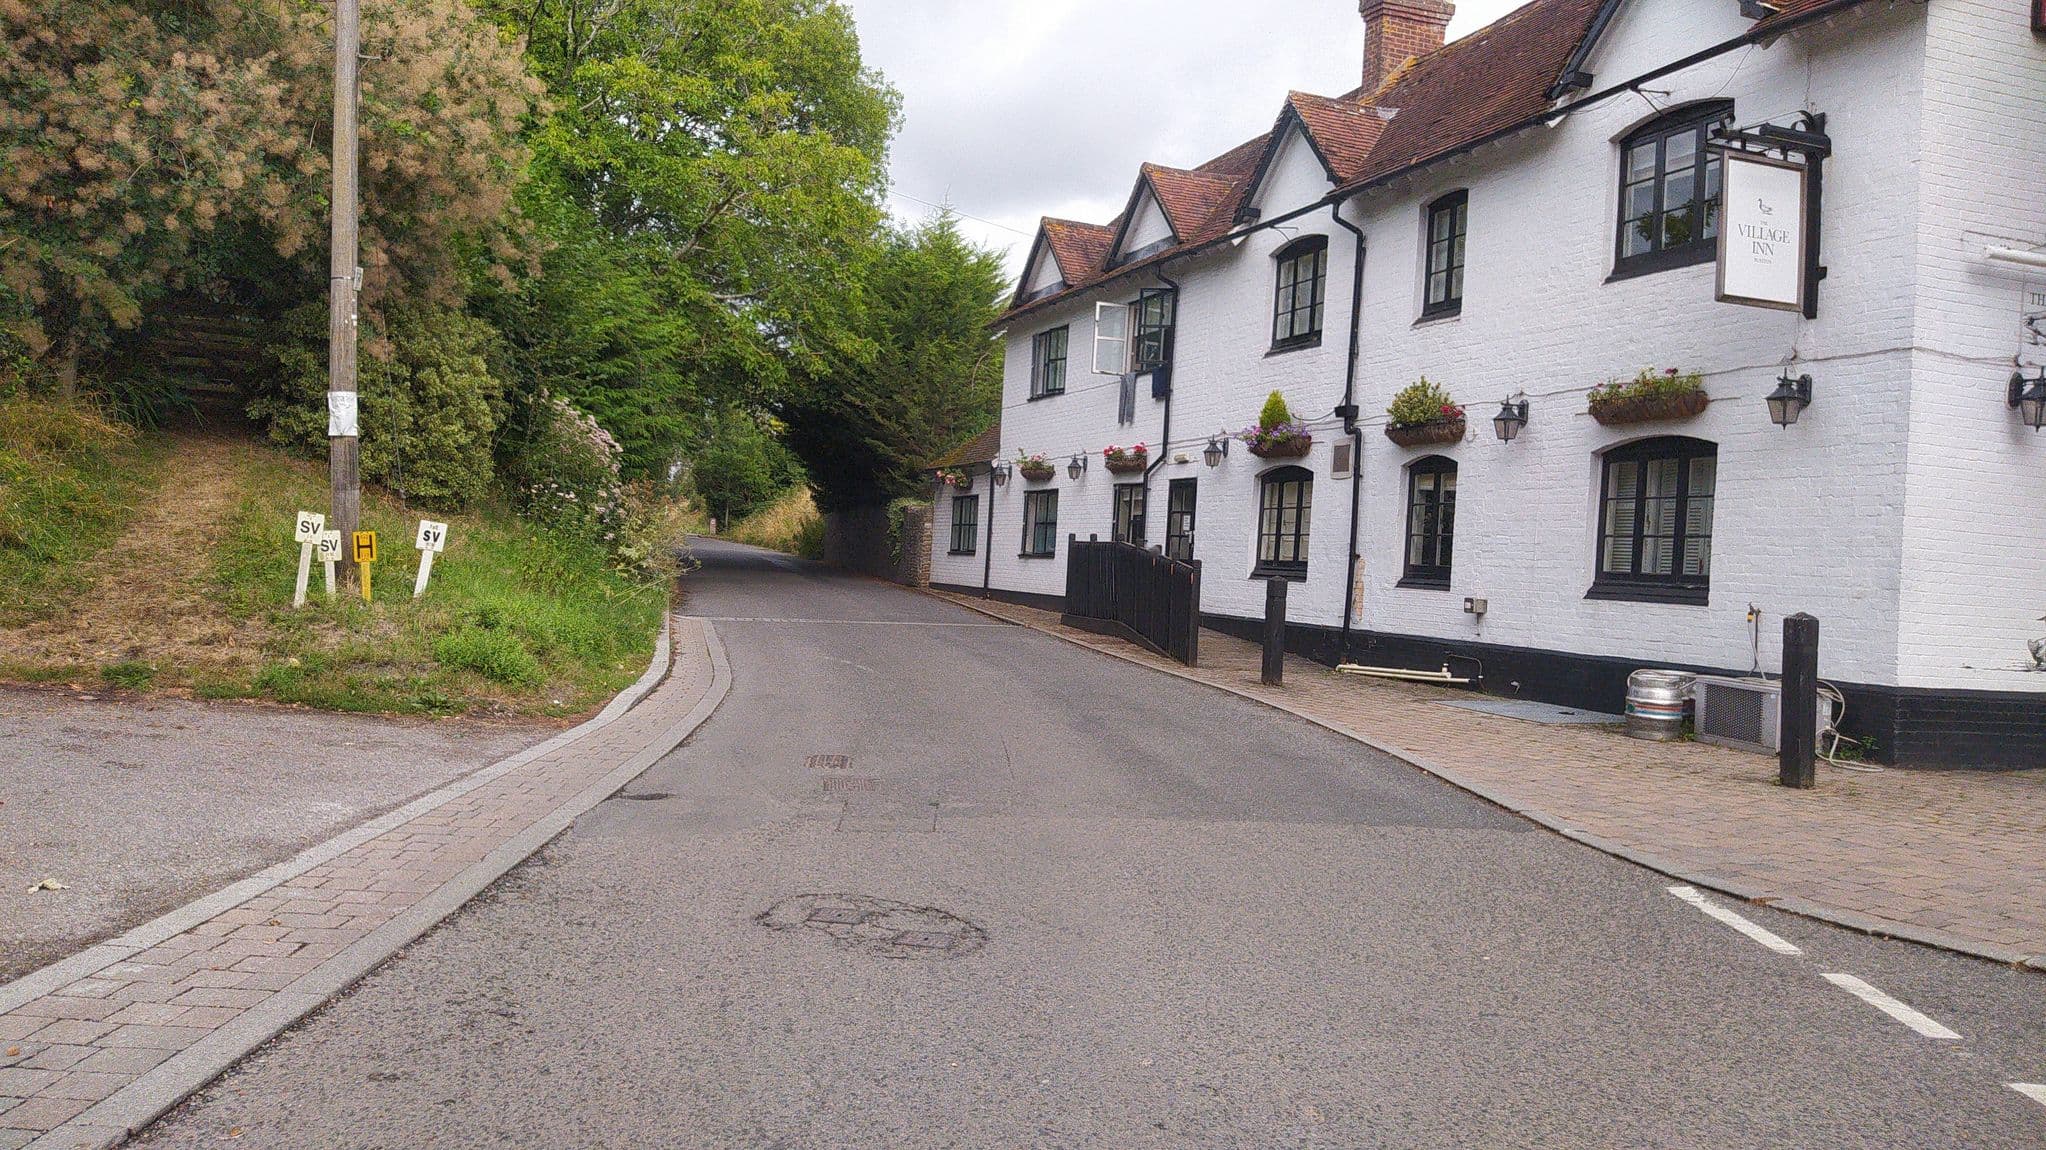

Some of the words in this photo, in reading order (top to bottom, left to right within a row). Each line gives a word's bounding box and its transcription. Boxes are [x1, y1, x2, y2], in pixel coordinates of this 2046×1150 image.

[1738, 223, 1790, 244] VILLAGE
[1752, 241, 1774, 256] INN
[300, 520, 321, 535] SV
[423, 530, 441, 543] SV
[320, 539, 338, 552] SV
[356, 534, 373, 559] H
